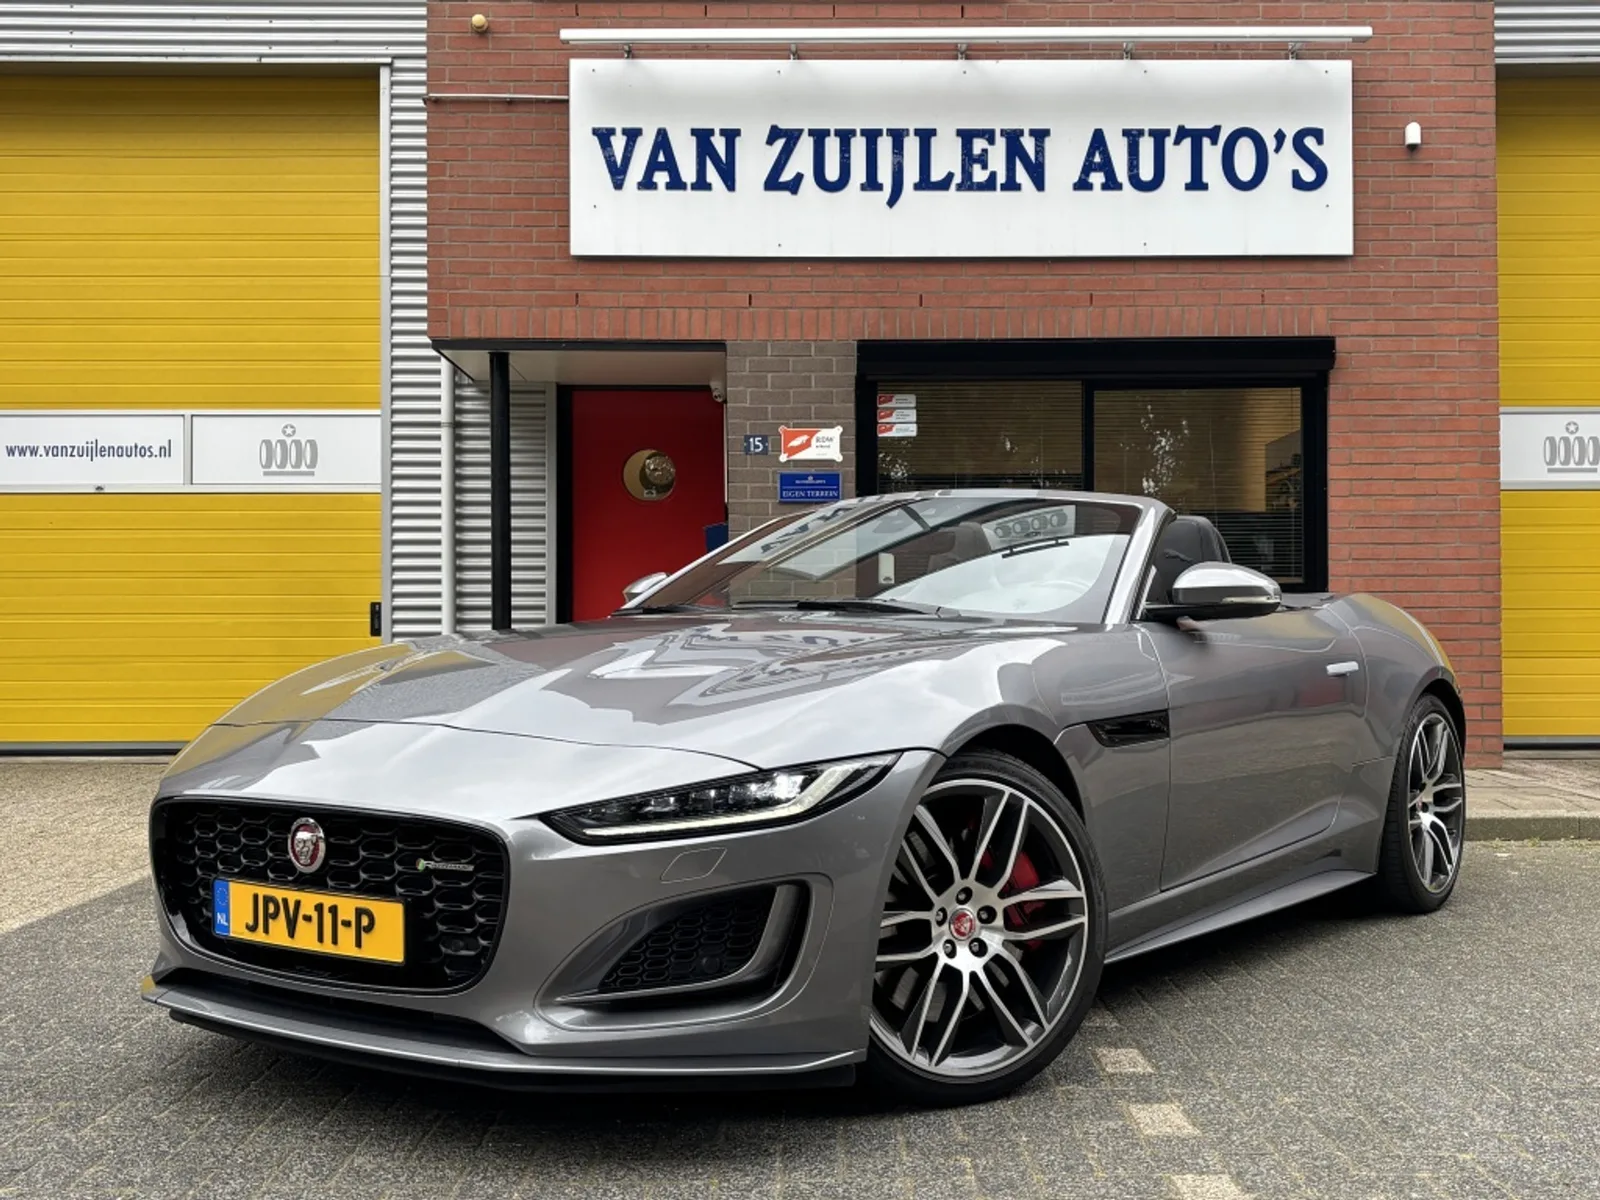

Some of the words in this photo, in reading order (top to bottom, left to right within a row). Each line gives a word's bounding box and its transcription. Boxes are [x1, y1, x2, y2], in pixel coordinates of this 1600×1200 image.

[592, 127, 741, 191] VAN
[764, 125, 1050, 208] ZUIJLEN
[1073, 125, 1328, 192] AUTO'S
[5, 439, 172, 462] www.vanzuijlenautos.nl
[749, 437, 764, 452] 15
[782, 490, 805, 498] EIGEN
[807, 490, 838, 498] TERREIN
[216, 912, 229, 926] NL
[245, 893, 375, 949] JPV-11-P
